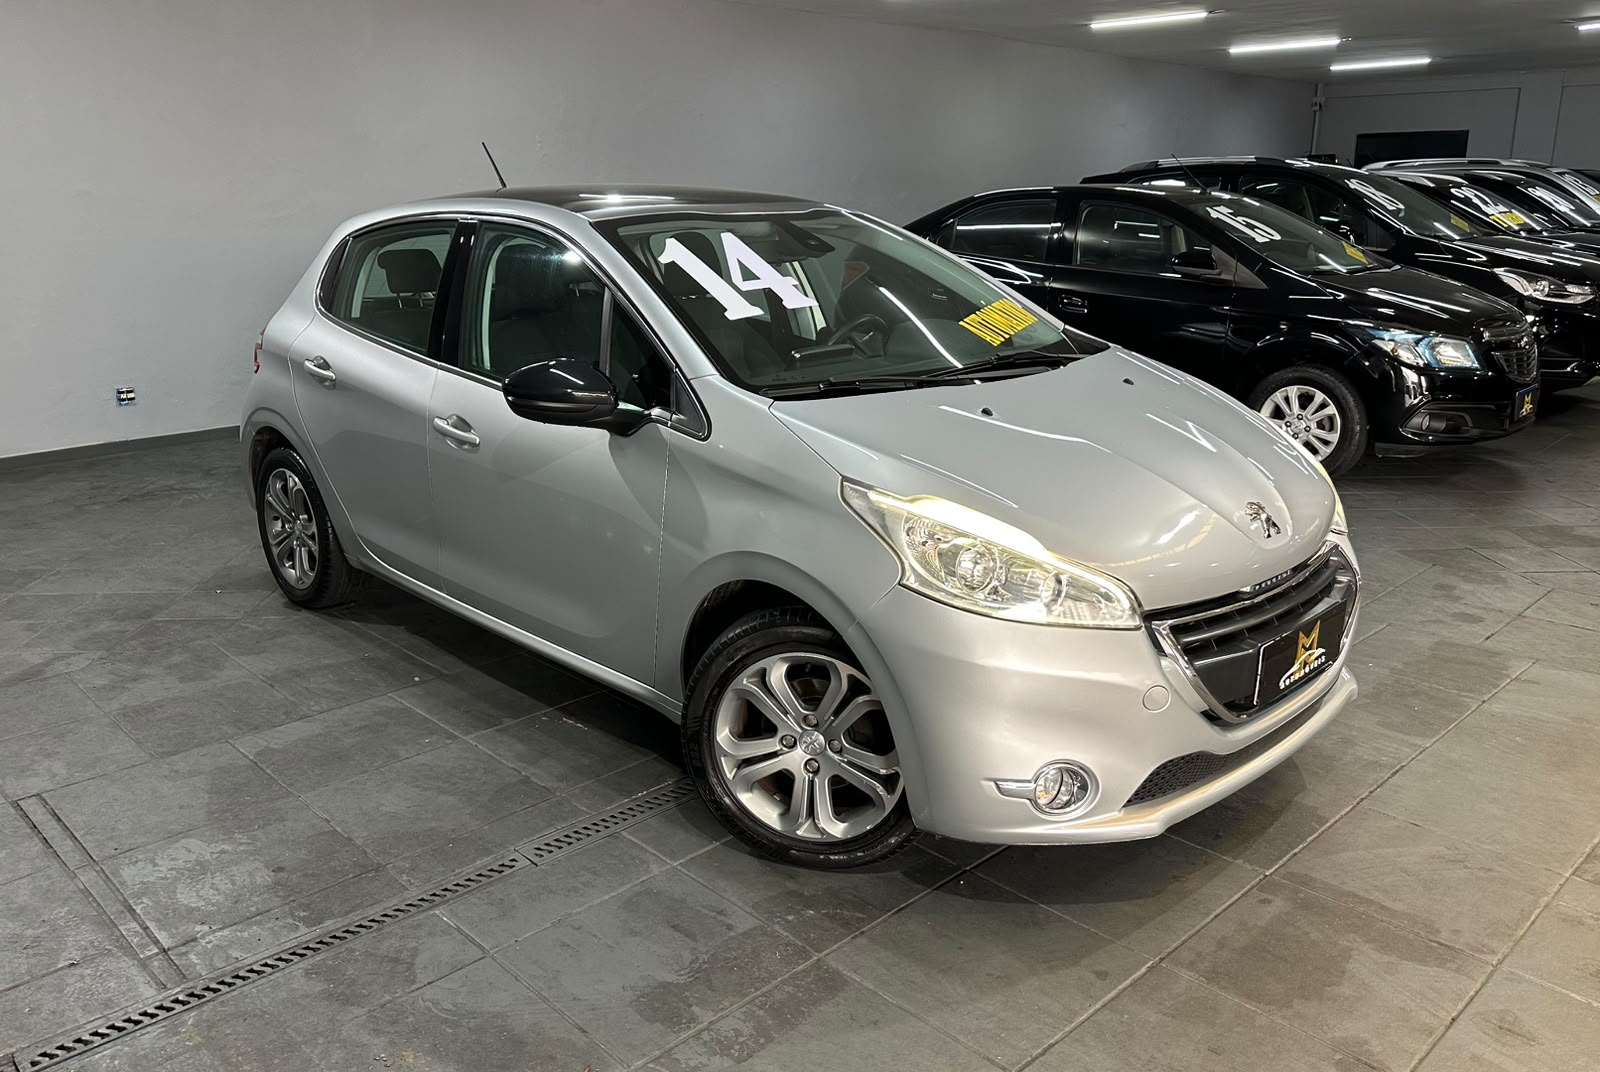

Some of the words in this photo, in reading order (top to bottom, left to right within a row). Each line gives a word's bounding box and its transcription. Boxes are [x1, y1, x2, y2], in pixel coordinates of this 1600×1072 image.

[1345, 179, 1405, 210] 18
[1450, 187, 1510, 215] 22
[1205, 205, 1281, 243] 15
[657, 232, 818, 320] 14
